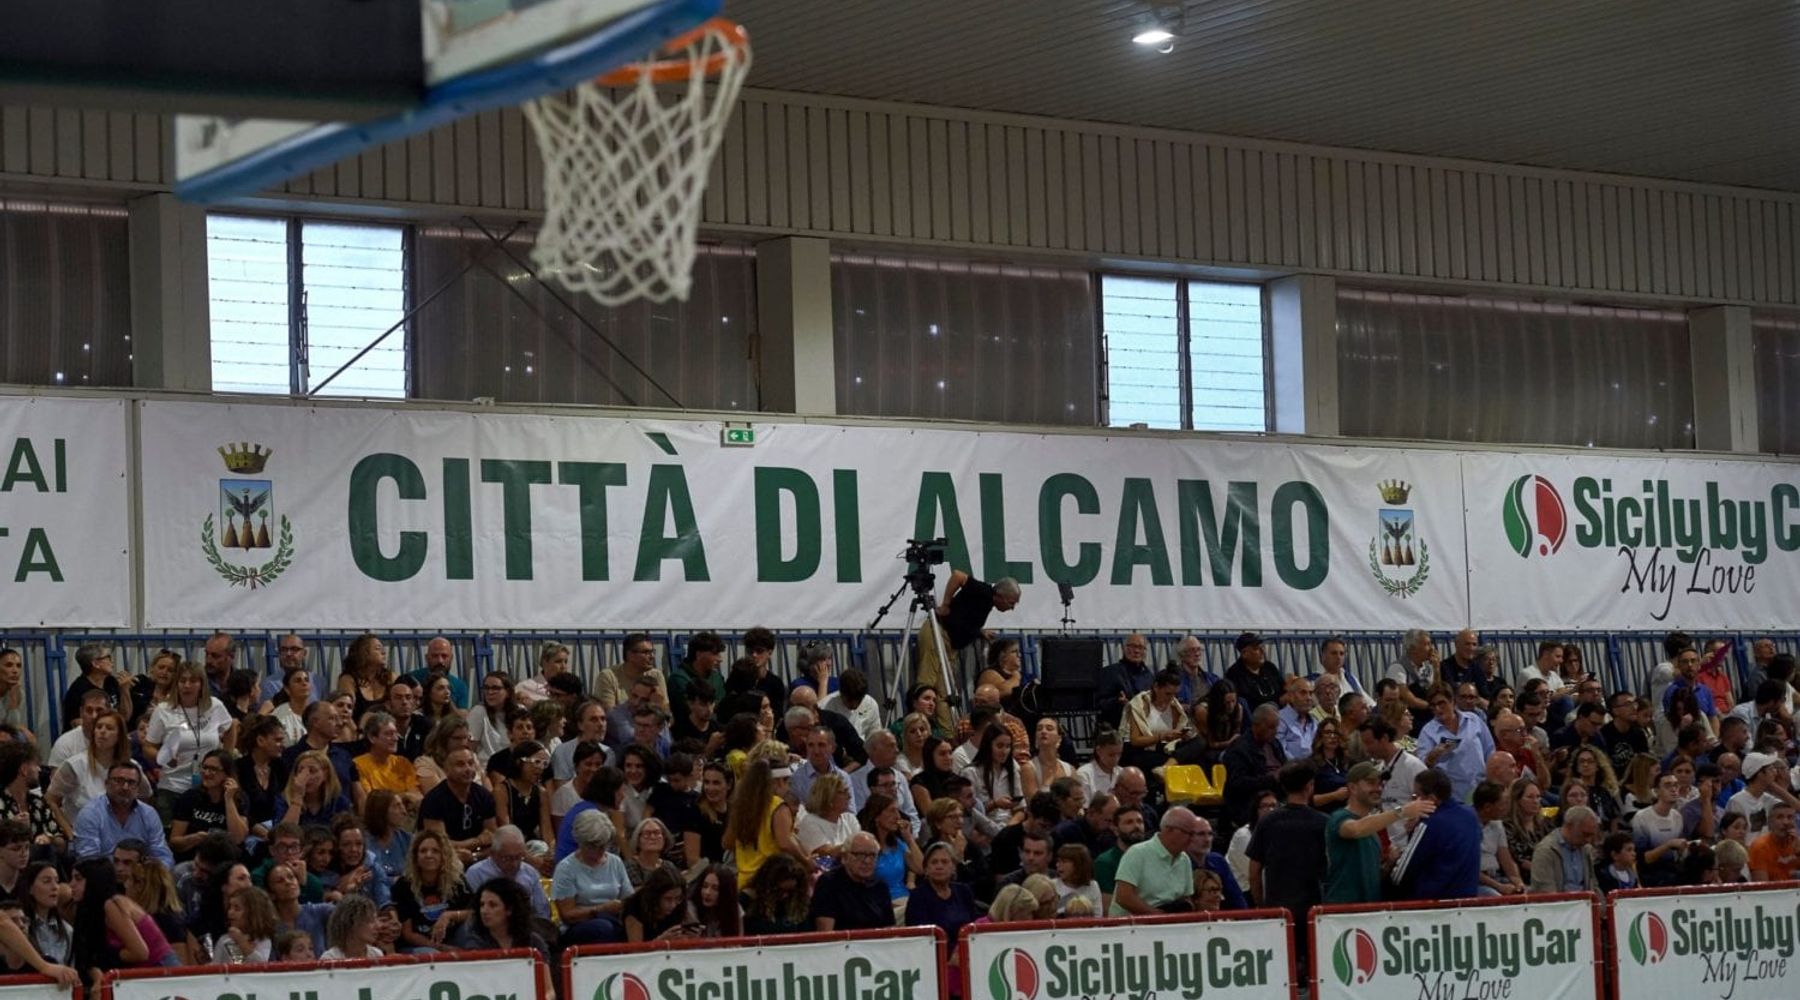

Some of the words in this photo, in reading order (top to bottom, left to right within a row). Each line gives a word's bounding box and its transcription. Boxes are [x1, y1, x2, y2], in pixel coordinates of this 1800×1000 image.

[0, 437, 67, 493] AI
[348, 432, 711, 583] CITTÀ
[754, 466, 863, 584] DI
[912, 470, 1330, 591] ALCAMO
[0, 527, 65, 583] A
[1618, 546, 1677, 621] My
[1686, 547, 1756, 595] Love
[1700, 952, 1737, 1000] My
[1743, 950, 1788, 982] Love
